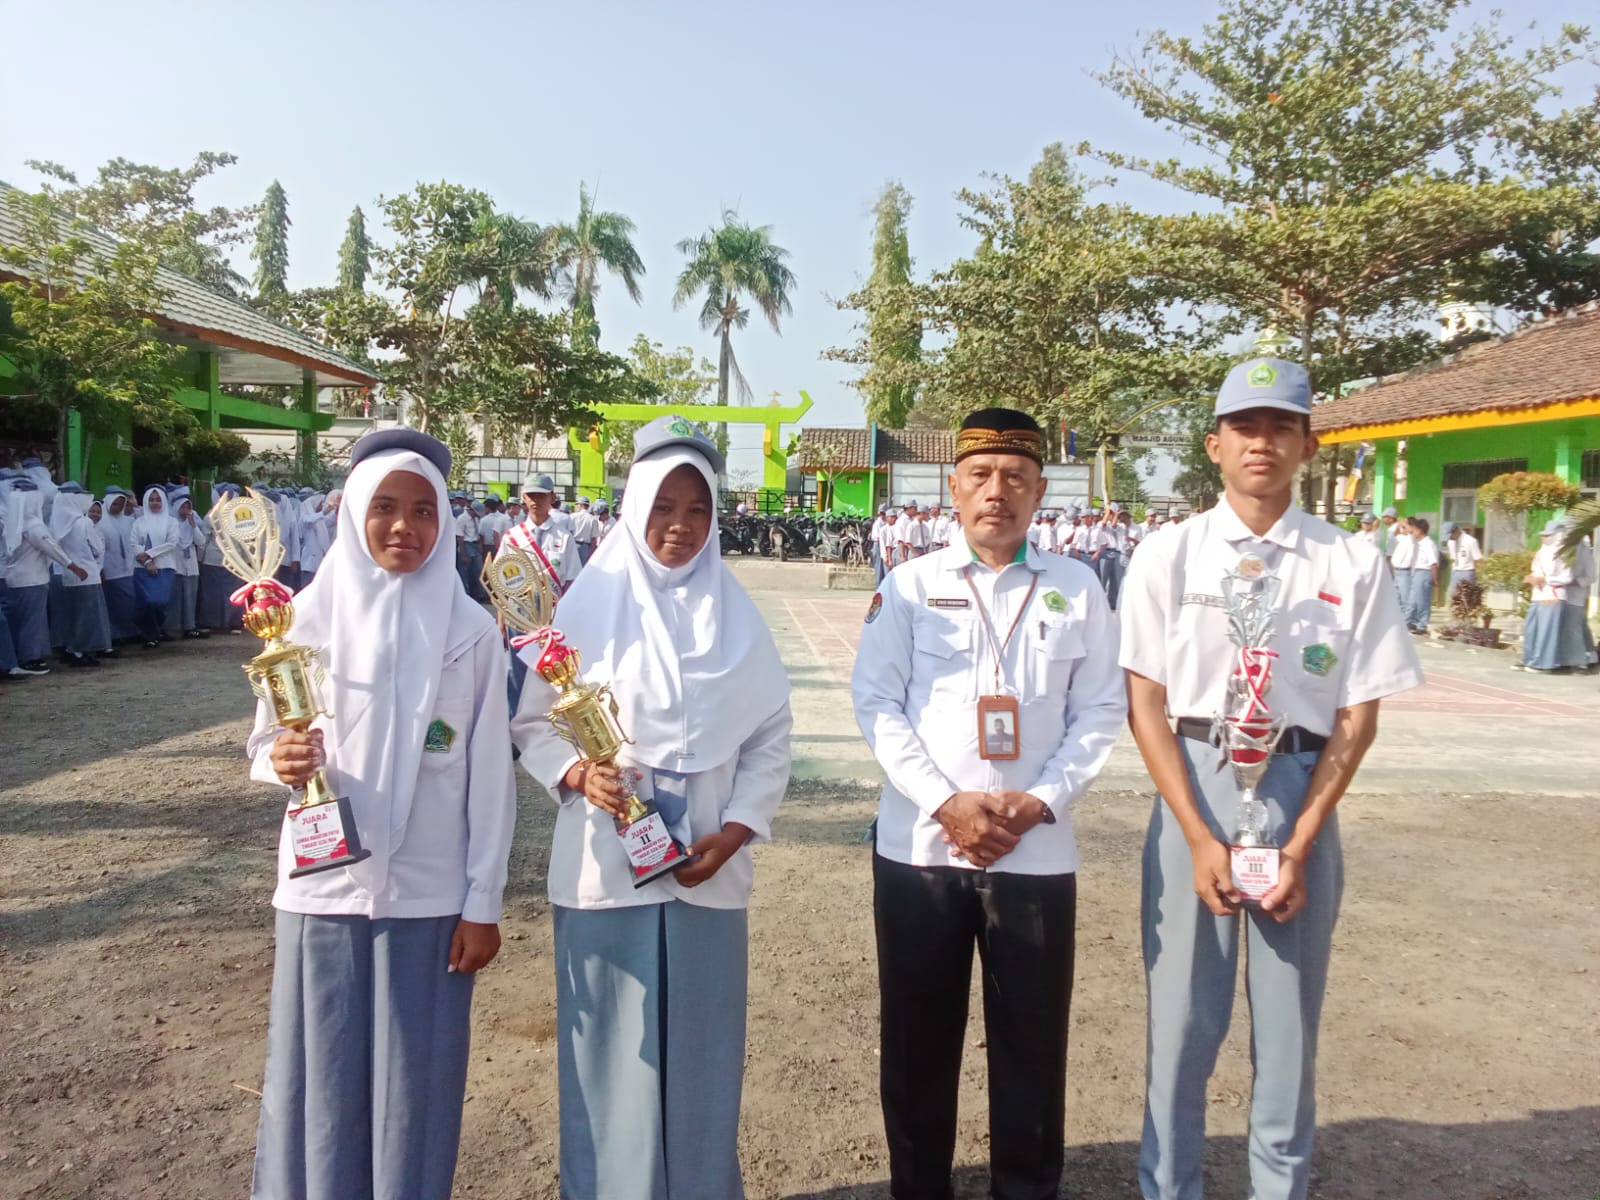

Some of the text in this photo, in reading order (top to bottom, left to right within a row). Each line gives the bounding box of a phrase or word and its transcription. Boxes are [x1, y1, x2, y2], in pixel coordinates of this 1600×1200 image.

[1132, 434, 1161, 442] MASJID
[302, 813, 328, 825] JUARA
[313, 823, 319, 833] I
[631, 824, 654, 839] JUARA
[640, 833, 651, 844] II
[1249, 863, 1263, 872] III
